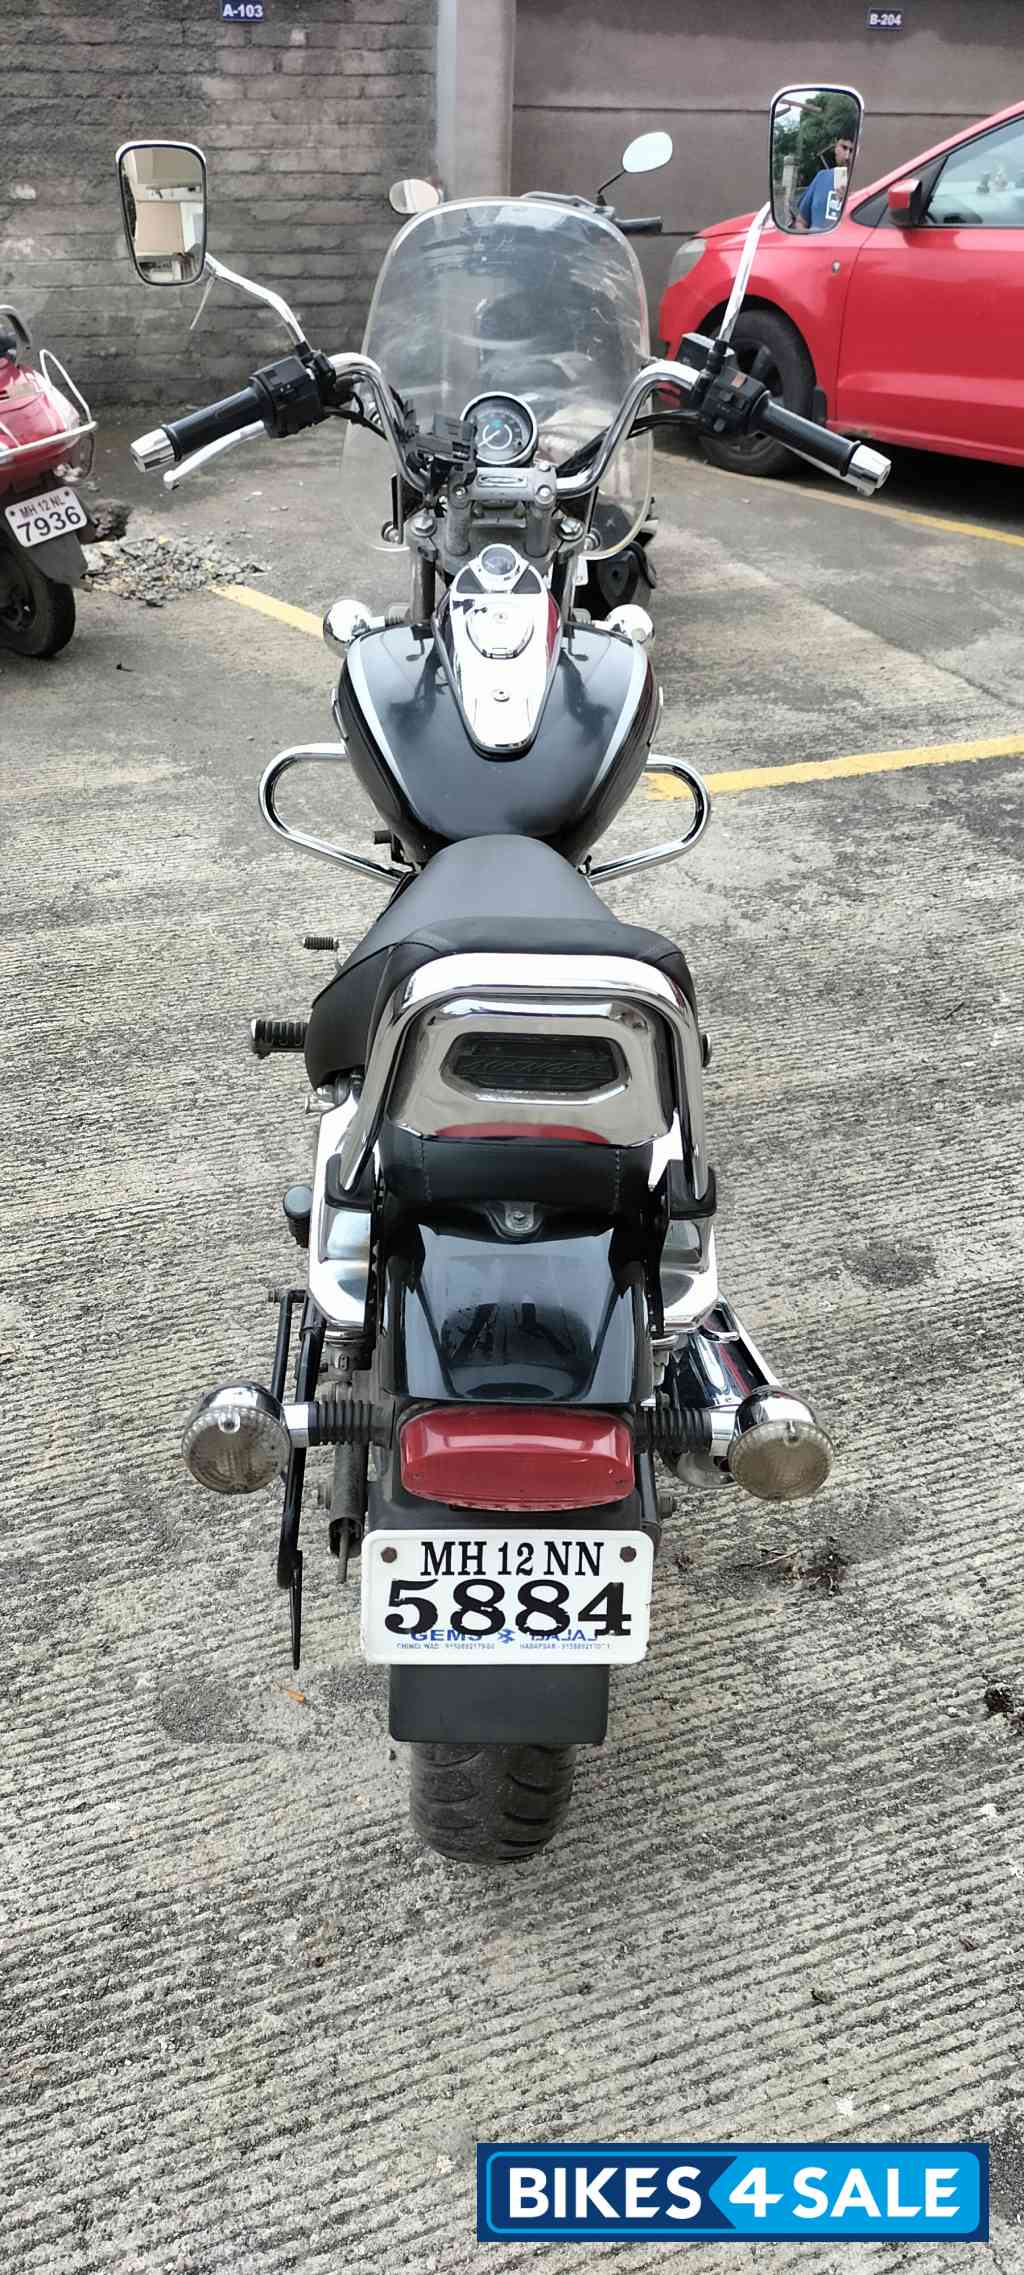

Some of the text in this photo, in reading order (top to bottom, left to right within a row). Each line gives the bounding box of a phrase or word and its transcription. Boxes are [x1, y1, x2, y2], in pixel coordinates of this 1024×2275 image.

[222, 3, 264, 18] A-103
[870, 13, 902, 26] B-204
[19, 503, 37, 516] MH
[38, 499, 50, 512] 12
[16, 506, 81, 542] 7936
[420, 1541, 604, 1577] MH 12 NN
[384, 1578, 632, 1636] 5884
